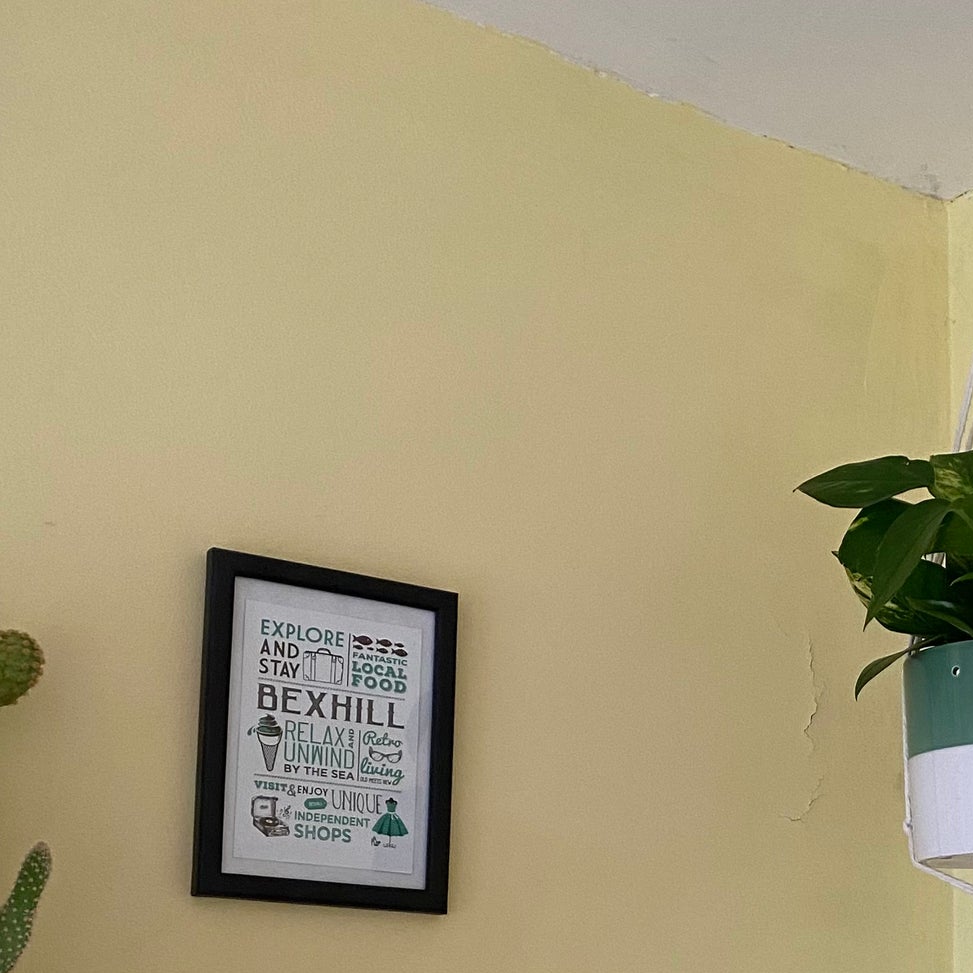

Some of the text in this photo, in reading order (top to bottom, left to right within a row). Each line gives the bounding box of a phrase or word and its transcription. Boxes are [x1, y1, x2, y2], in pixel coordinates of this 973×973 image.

[261, 618, 344, 647] EXPLORE
[260, 638, 299, 659] AND
[352, 651, 408, 666] FANTASTIC
[259, 658, 300, 679] STAY
[351, 661, 408, 680] LOCAL
[351, 673, 407, 694] FOOD
[257, 683, 405, 729] BEXHILL
[285, 719, 345, 747] RELAX
[362, 730, 403, 748] Retro
[284, 741, 355, 769] UNWIND
[284, 764, 355, 781] BY THE SEA
[360, 757, 405, 786] living
[254, 780, 288, 792] VISIT
[297, 785, 329, 797] ENJOY
[331, 789, 383, 815] UNIQUE
[294, 810, 371, 828] INDEPENDENT
[293, 824, 352, 844] SHOPS
